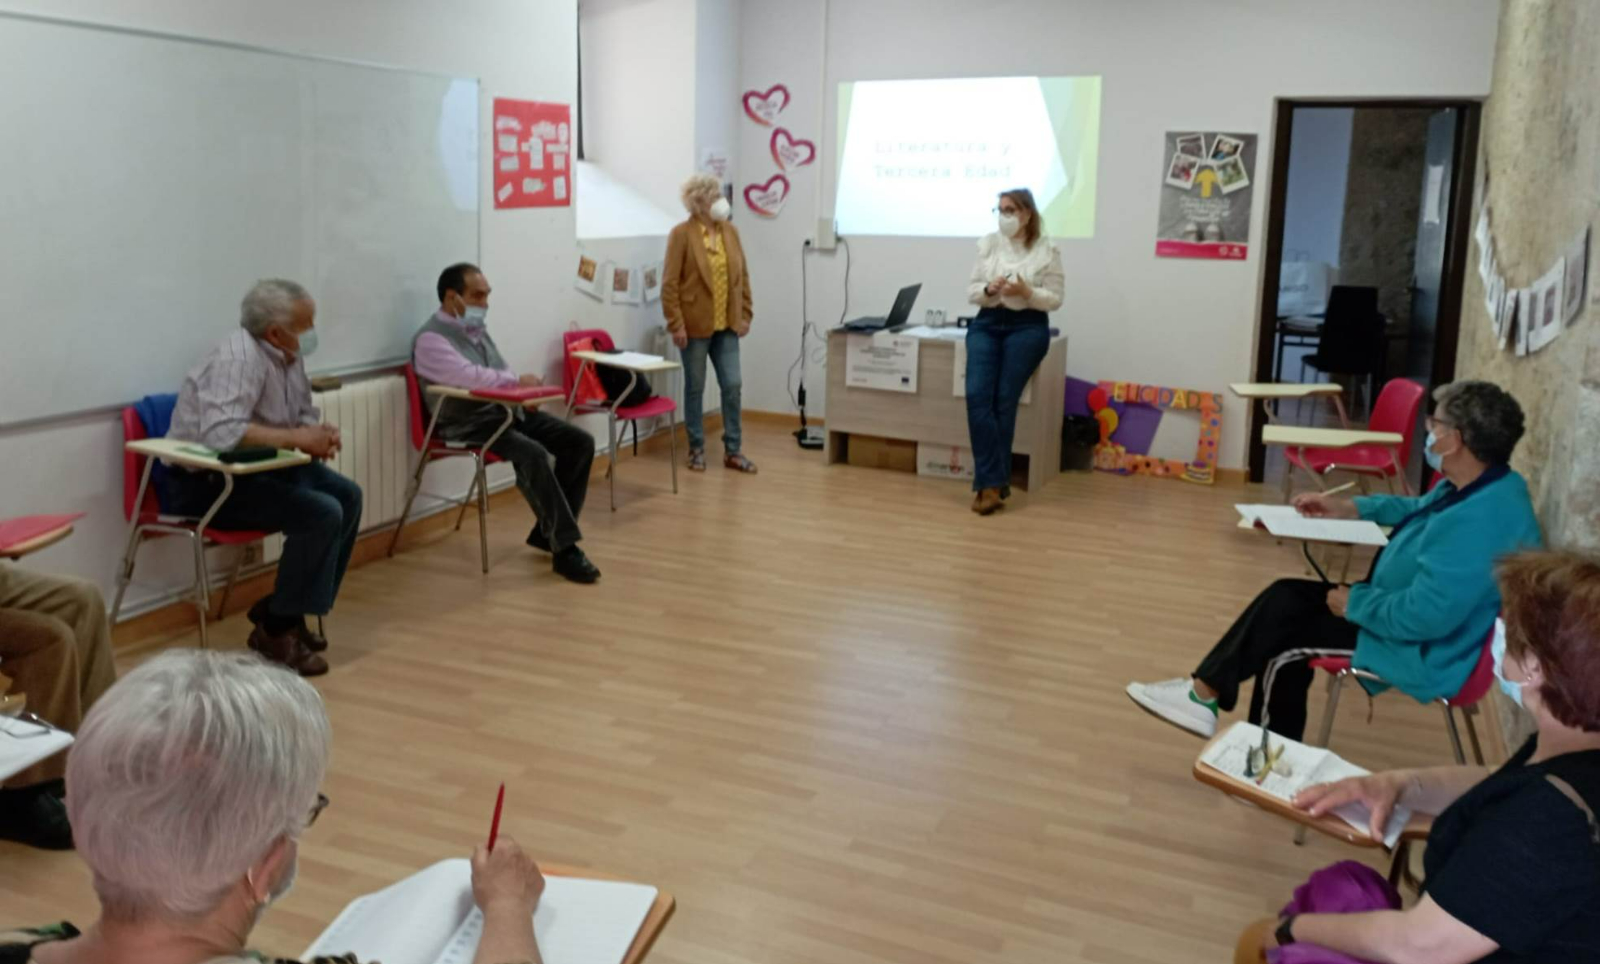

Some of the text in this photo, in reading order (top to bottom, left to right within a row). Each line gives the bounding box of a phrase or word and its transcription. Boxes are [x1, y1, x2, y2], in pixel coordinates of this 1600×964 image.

[874, 140, 1012, 156] Literatura y
[874, 162, 1011, 178] Tercera Edad
